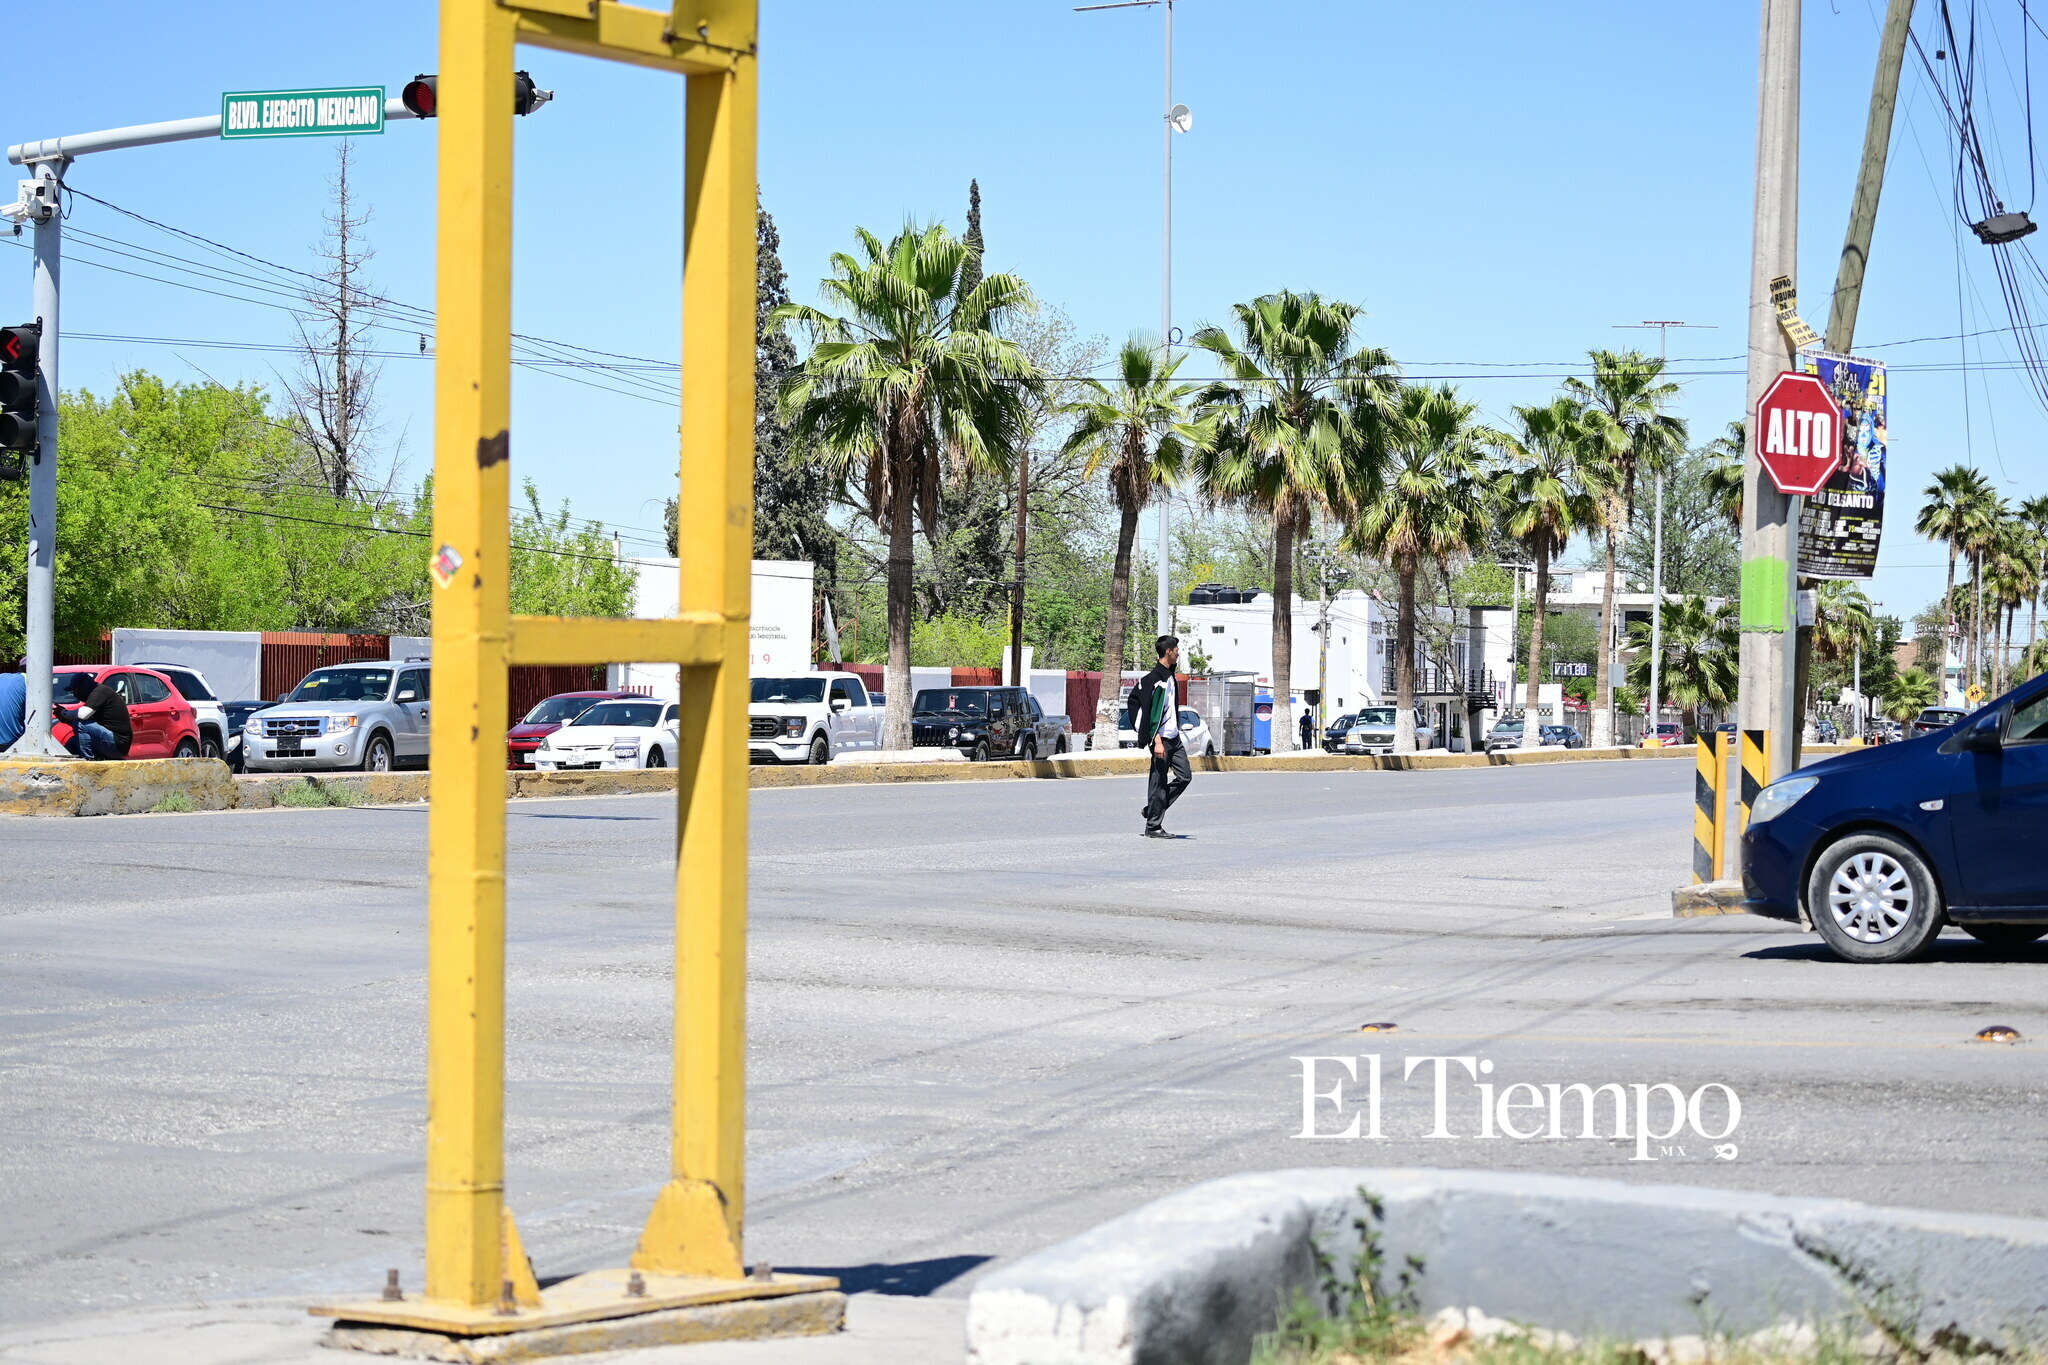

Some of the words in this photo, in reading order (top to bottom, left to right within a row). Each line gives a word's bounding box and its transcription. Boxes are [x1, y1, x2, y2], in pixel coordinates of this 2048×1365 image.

[228, 100, 260, 130] BLVD.
[262, 98, 315, 129] EJERCITO
[317, 95, 378, 127] MEXICANO
[1867, 374, 1885, 396] 21
[1765, 407, 1832, 459] ALTO
